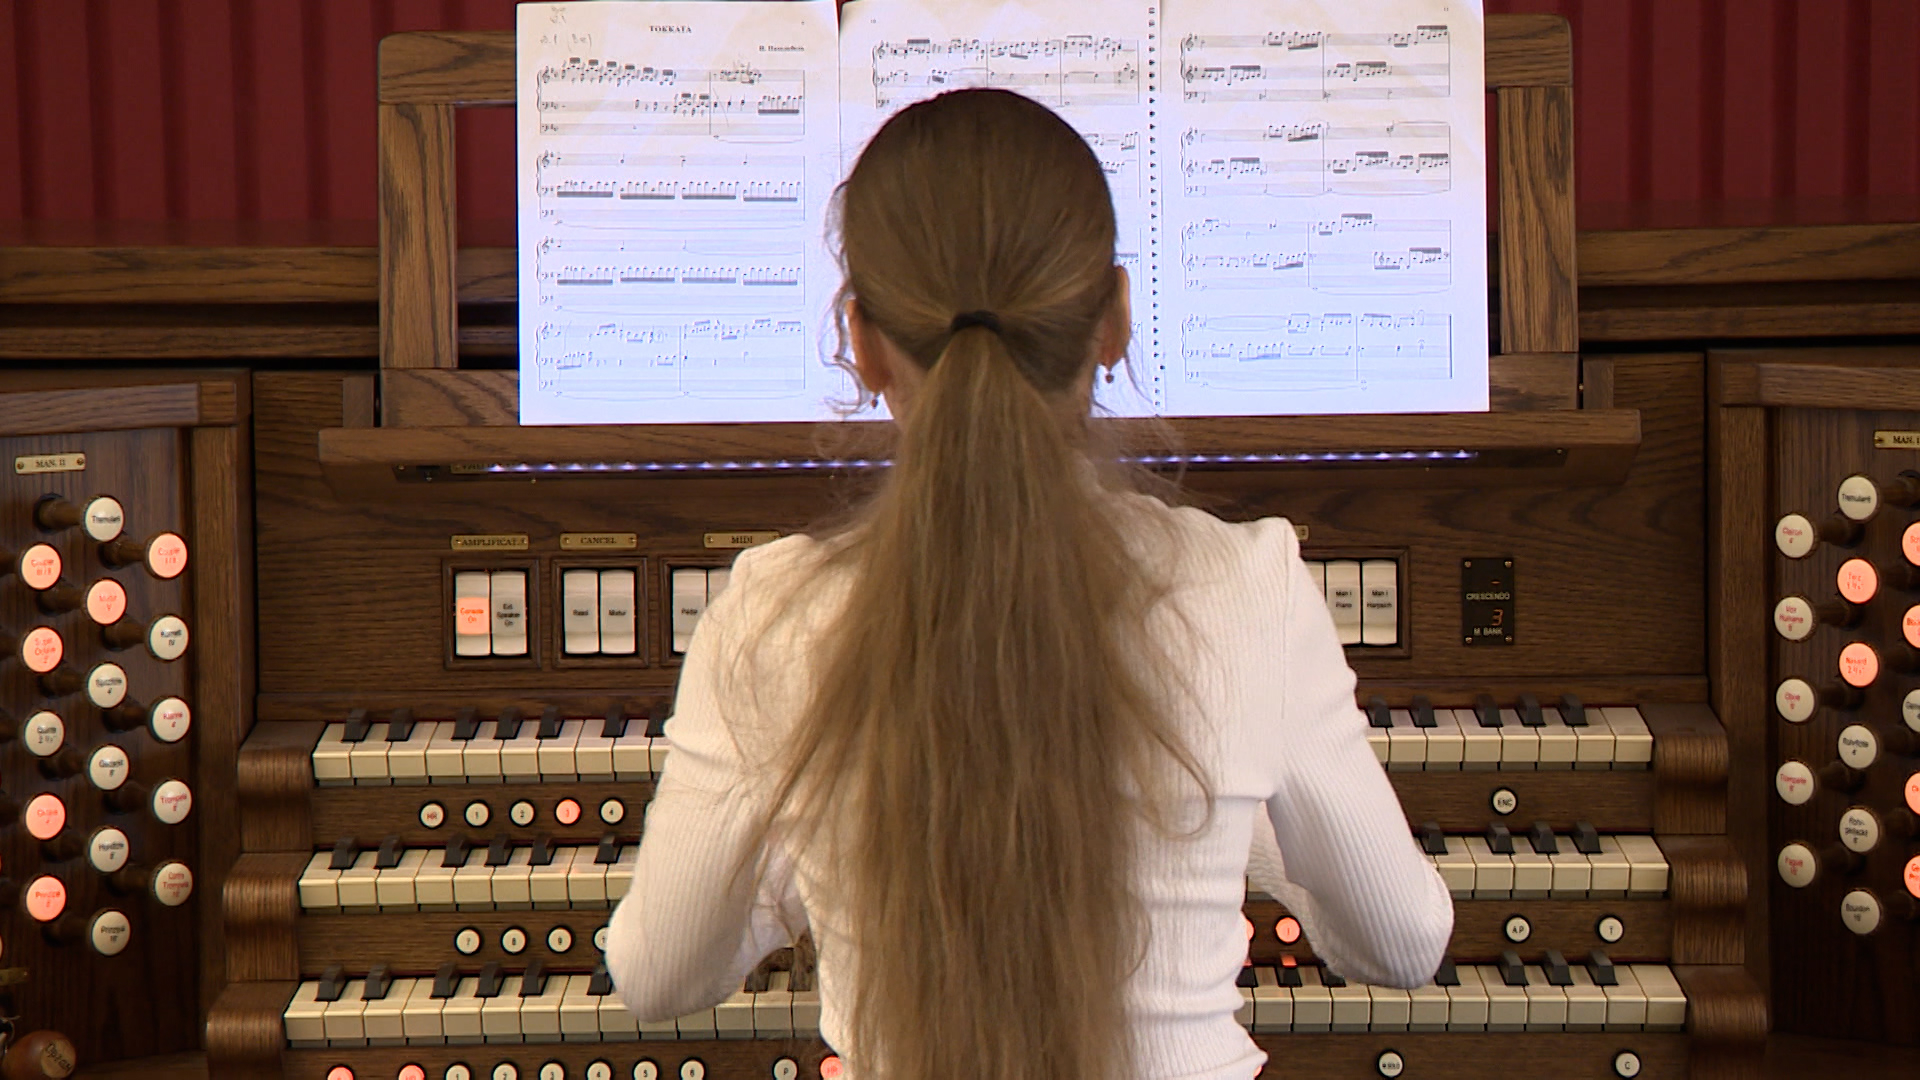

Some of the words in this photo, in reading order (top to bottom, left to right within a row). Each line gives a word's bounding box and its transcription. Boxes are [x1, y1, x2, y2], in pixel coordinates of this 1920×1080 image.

[35, 459, 57, 468] MAN.
[580, 537, 617, 545] CANCEL
[731, 536, 753, 544] MIDI
[1465, 592, 1510, 601] CRESCENDO
[1491, 608, 1504, 627] 3
[1483, 627, 1504, 636] BANK
